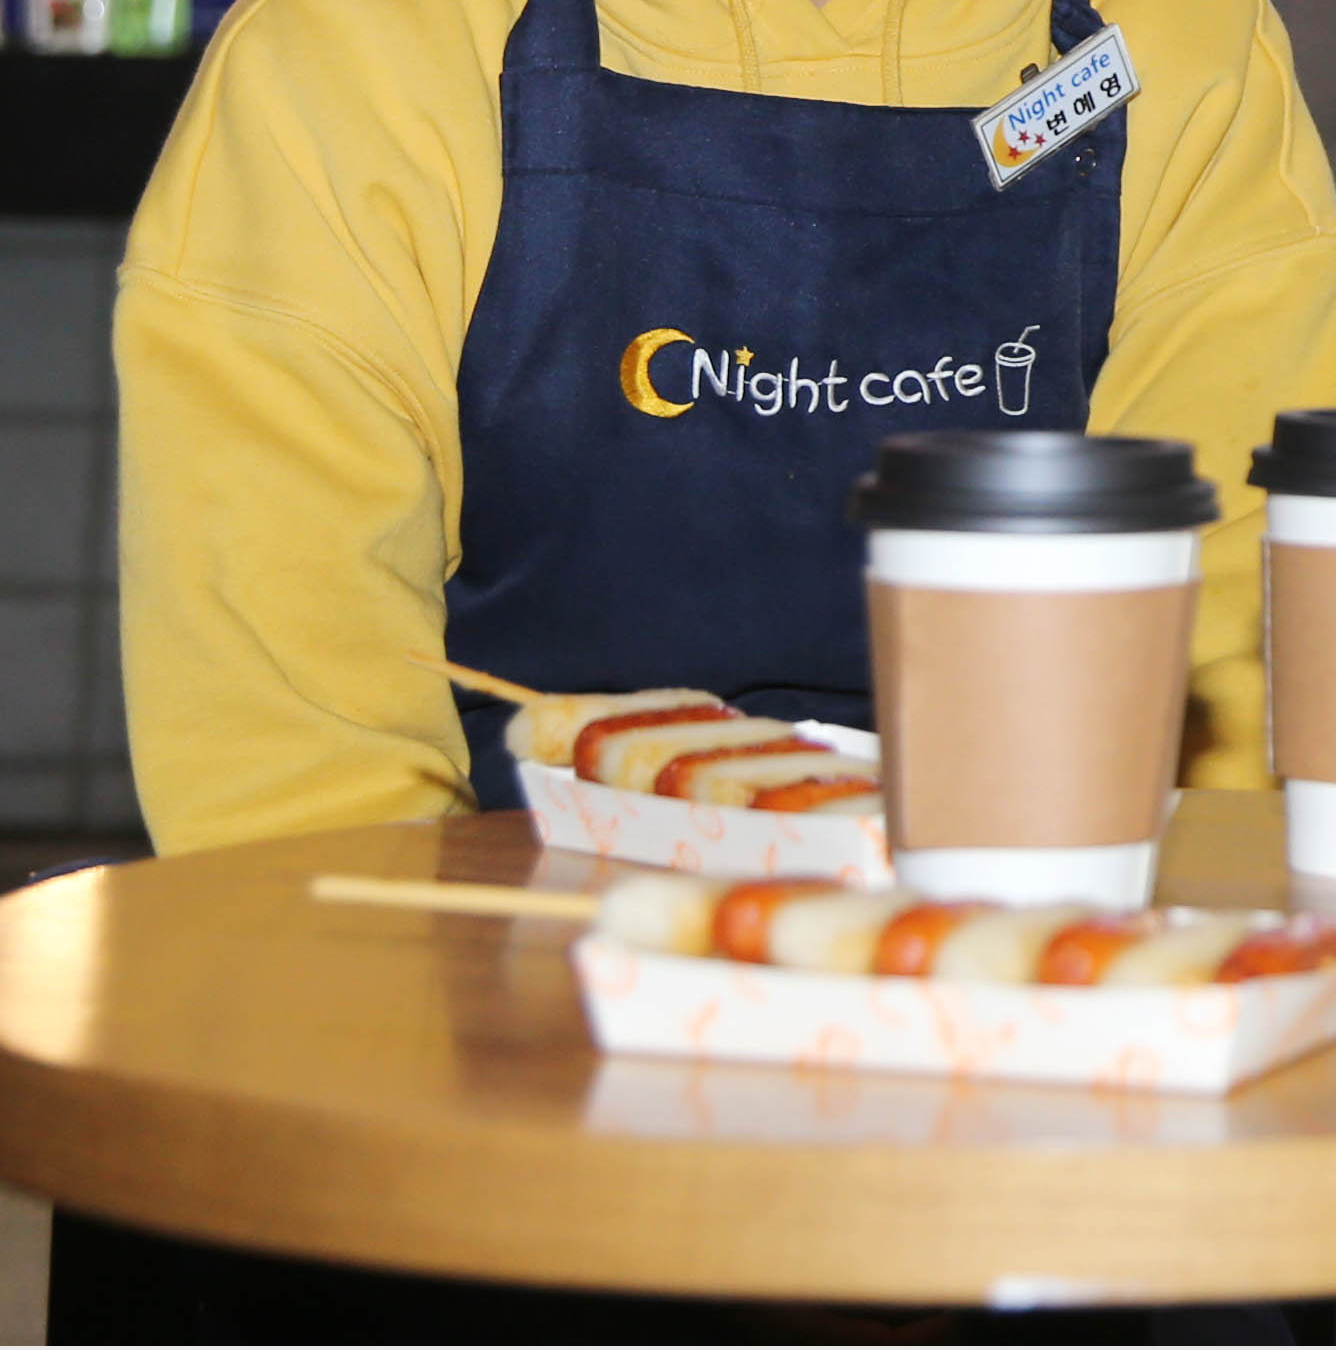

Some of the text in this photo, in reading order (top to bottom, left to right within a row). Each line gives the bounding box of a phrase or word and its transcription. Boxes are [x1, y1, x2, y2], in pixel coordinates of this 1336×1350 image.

[1007, 52, 1111, 131] Night cafe
[692, 347, 987, 417] Night cafe
